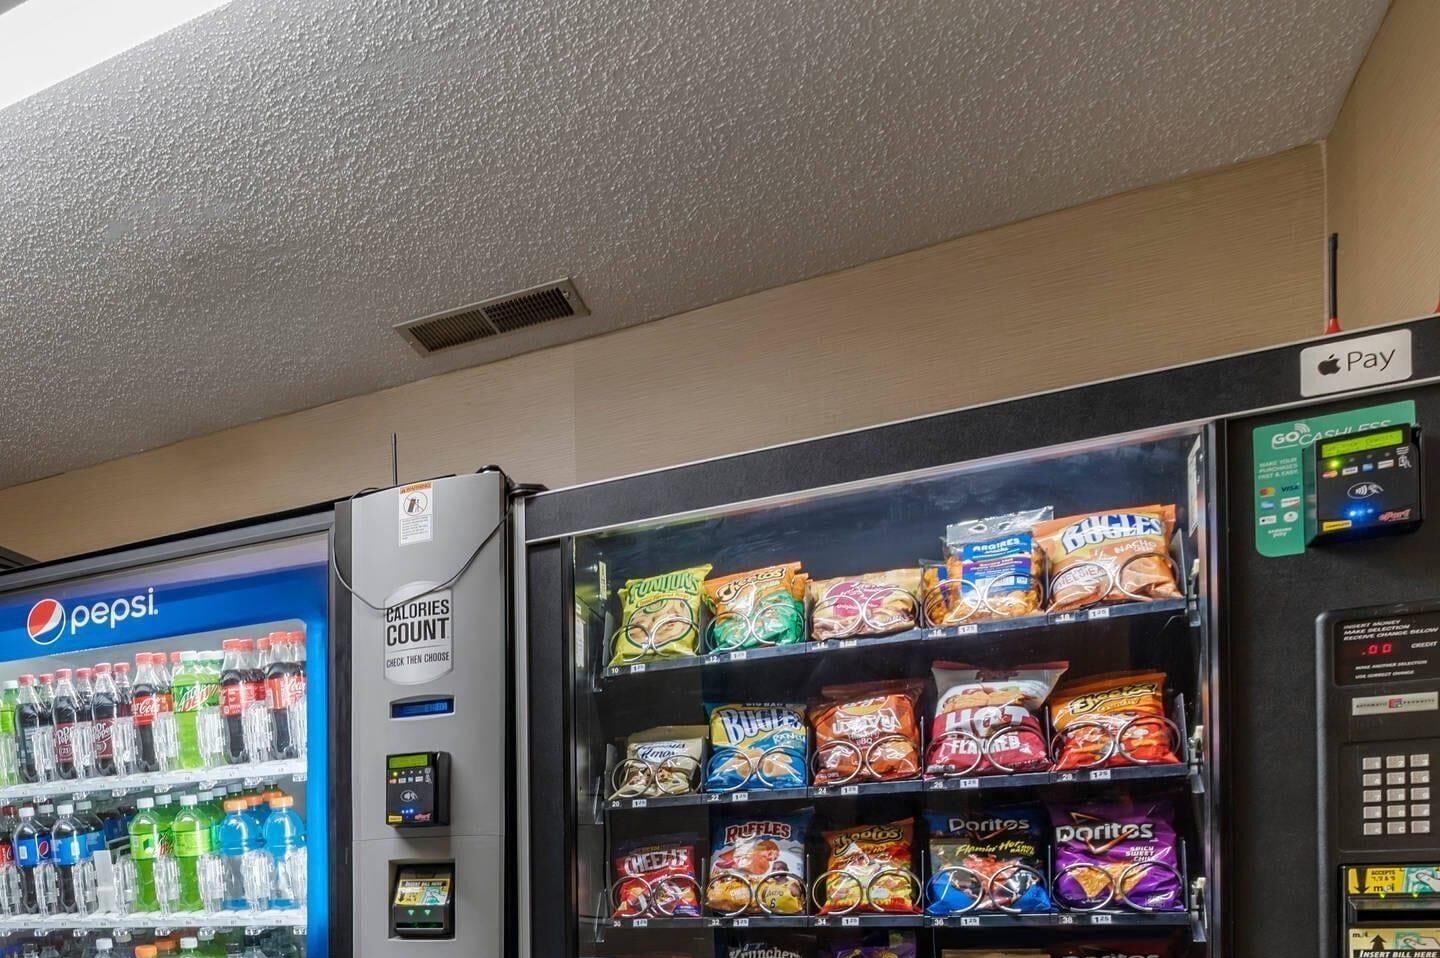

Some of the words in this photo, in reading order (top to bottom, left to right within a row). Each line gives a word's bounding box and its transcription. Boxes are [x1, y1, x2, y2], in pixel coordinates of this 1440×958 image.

[1347, 349, 1395, 373] Pay
[1273, 432, 1300, 446] GO
[70, 588, 155, 635] pepsi
[387, 599, 450, 623] CALORIES
[387, 617, 450, 647] COUNT
[1344, 633, 1375, 641] RECEIVE
[1376, 630, 1408, 638] CHANGE
[1366, 624, 1410, 633] SELECTION
[387, 654, 405, 669] CHECK
[406, 652, 422, 666] THEN
[424, 650, 450, 664] CHOOSE
[720, 707, 802, 746] BUGLES
[726, 821, 791, 845] RUFFLES
[948, 817, 1030, 833] Doritos
[1056, 822, 1153, 843] Doritos
[770, 900, 776, 909] 6
[1359, 950, 1391, 958] INSERT
